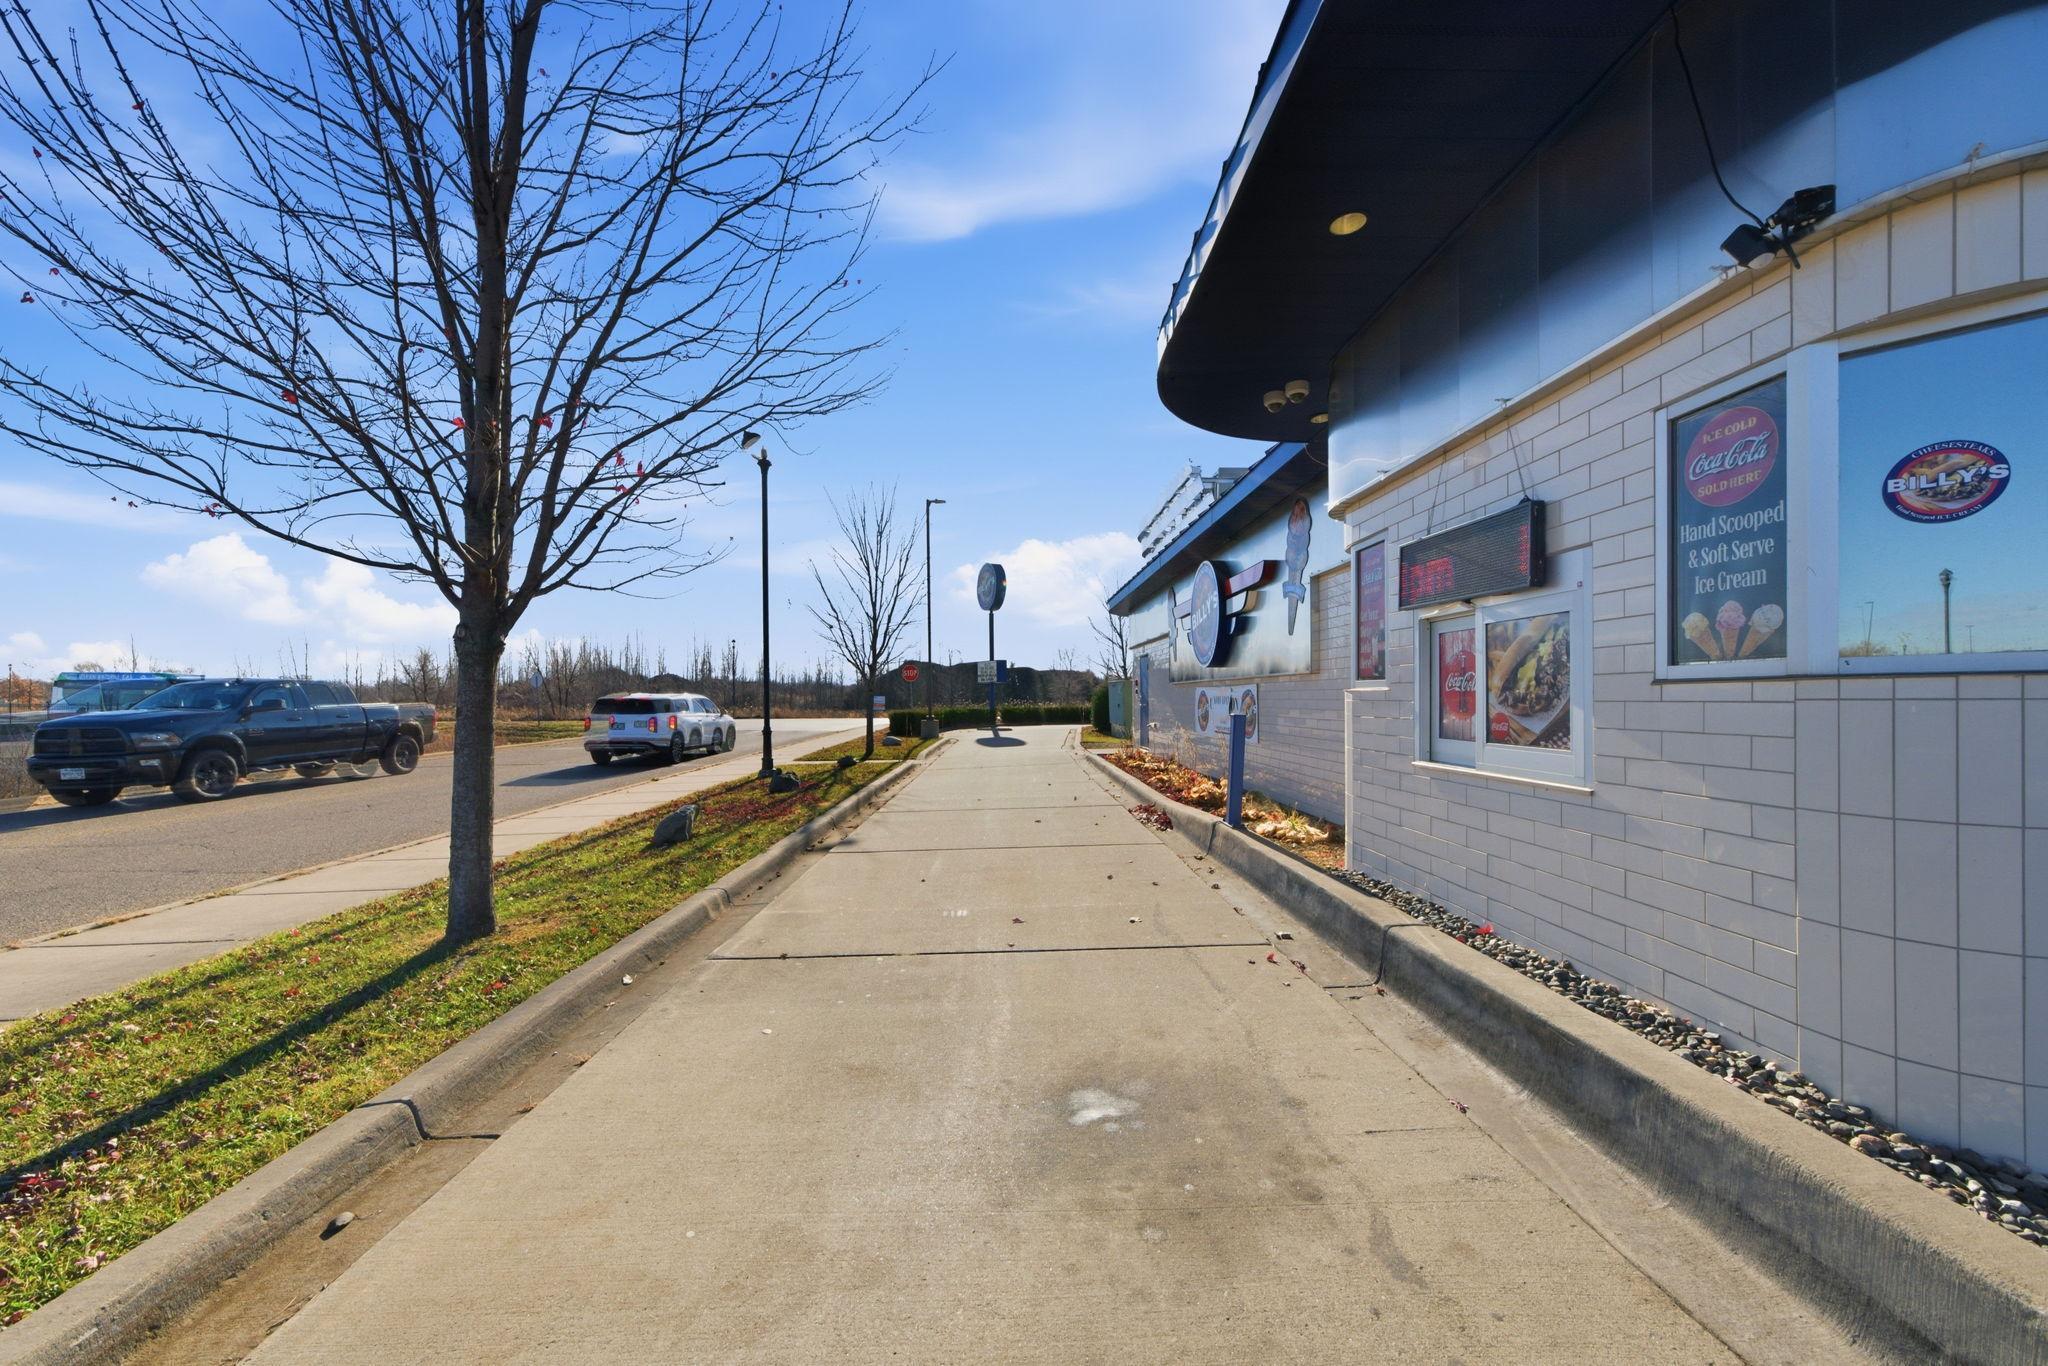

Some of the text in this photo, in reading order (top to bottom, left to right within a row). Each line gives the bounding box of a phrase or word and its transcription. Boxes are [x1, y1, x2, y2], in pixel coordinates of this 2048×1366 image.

[1703, 416, 1757, 444] ICE COLD
[1689, 431, 1772, 481] Coca-Cola
[1697, 470, 1762, 498] SOLD HERE
[1887, 464, 2010, 493] BILLY'S
[1680, 500, 1785, 544] Hand Scooped
[1688, 537, 1775, 569] & Soft Serve
[1695, 568, 1767, 595] Ice Cream
